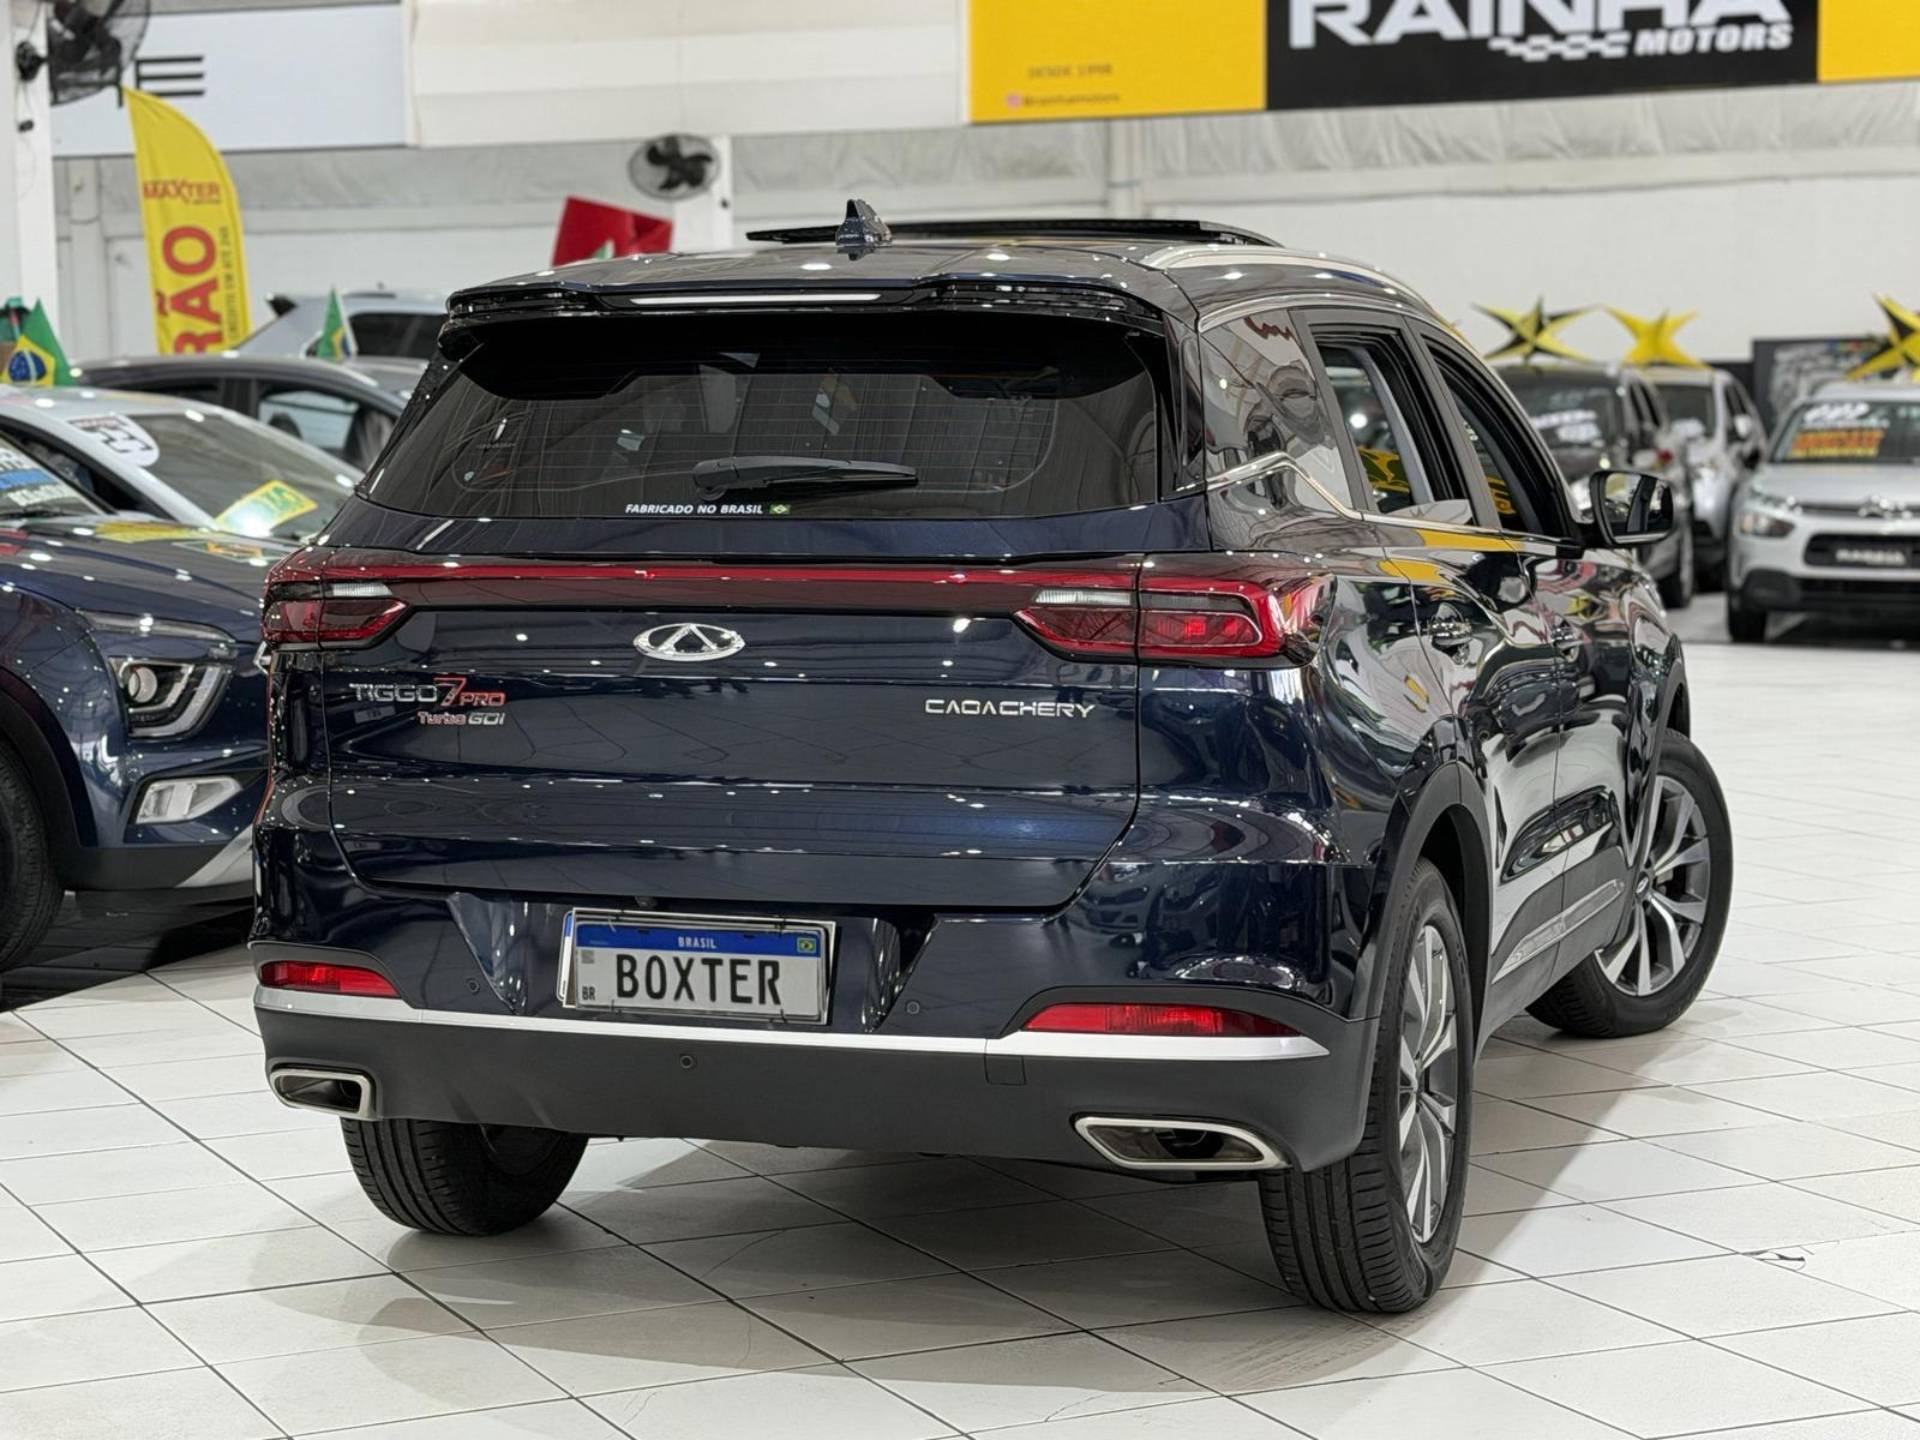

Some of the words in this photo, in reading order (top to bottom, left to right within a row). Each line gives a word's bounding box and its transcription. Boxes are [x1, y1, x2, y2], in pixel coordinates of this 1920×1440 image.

[1290, 0, 1793, 49] RAINHA
[1634, 22, 1793, 55] MOTORS
[625, 503, 694, 515] FABRICADO
[697, 504, 717, 515] NO
[720, 504, 764, 515] BRASIL
[349, 683, 438, 702] TIGGO
[433, 677, 467, 706] 7
[460, 692, 506, 707] PRO
[417, 711, 466, 725] Turbo
[678, 936, 717, 949] BRASIL
[616, 953, 781, 1006] BOXTER
[582, 986, 596, 1001] BR
